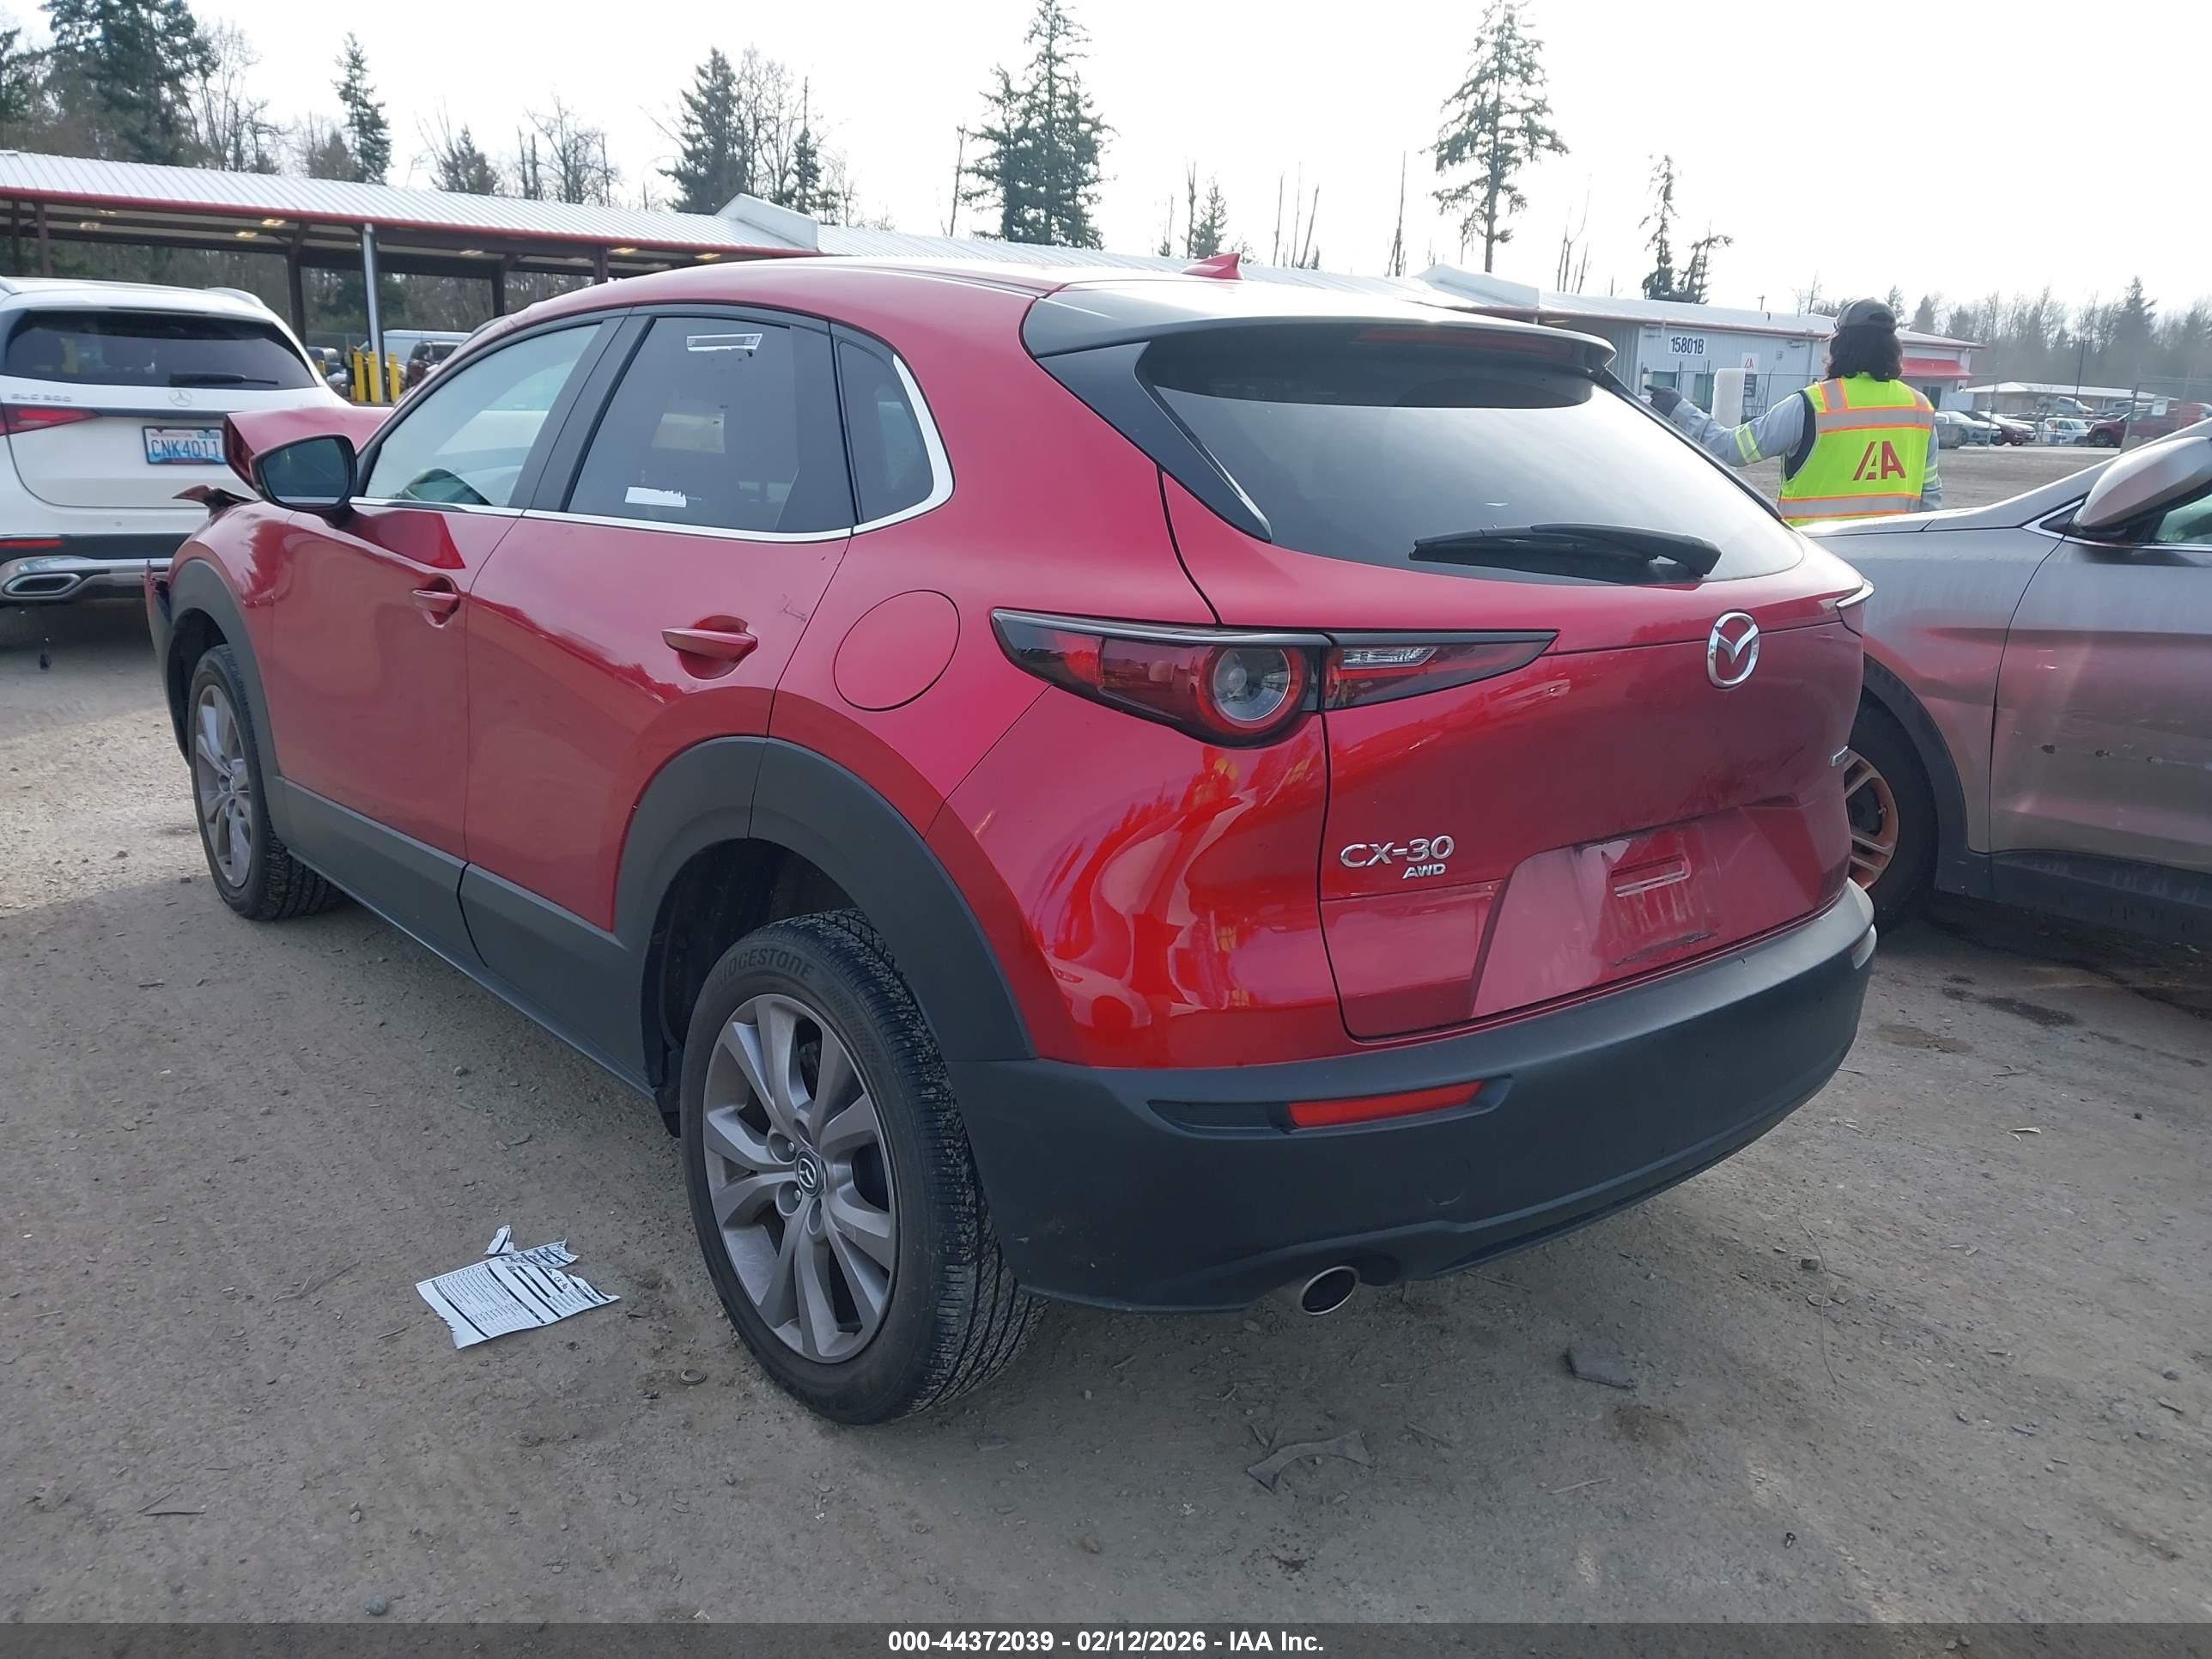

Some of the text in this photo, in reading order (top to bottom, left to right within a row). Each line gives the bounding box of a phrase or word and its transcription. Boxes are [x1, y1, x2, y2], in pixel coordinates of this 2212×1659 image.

[1671, 337, 1705, 354] 15801B
[151, 439, 220, 459] CNK4011
[1340, 836, 1455, 867] CX-30
[1401, 863, 1446, 879] AWD
